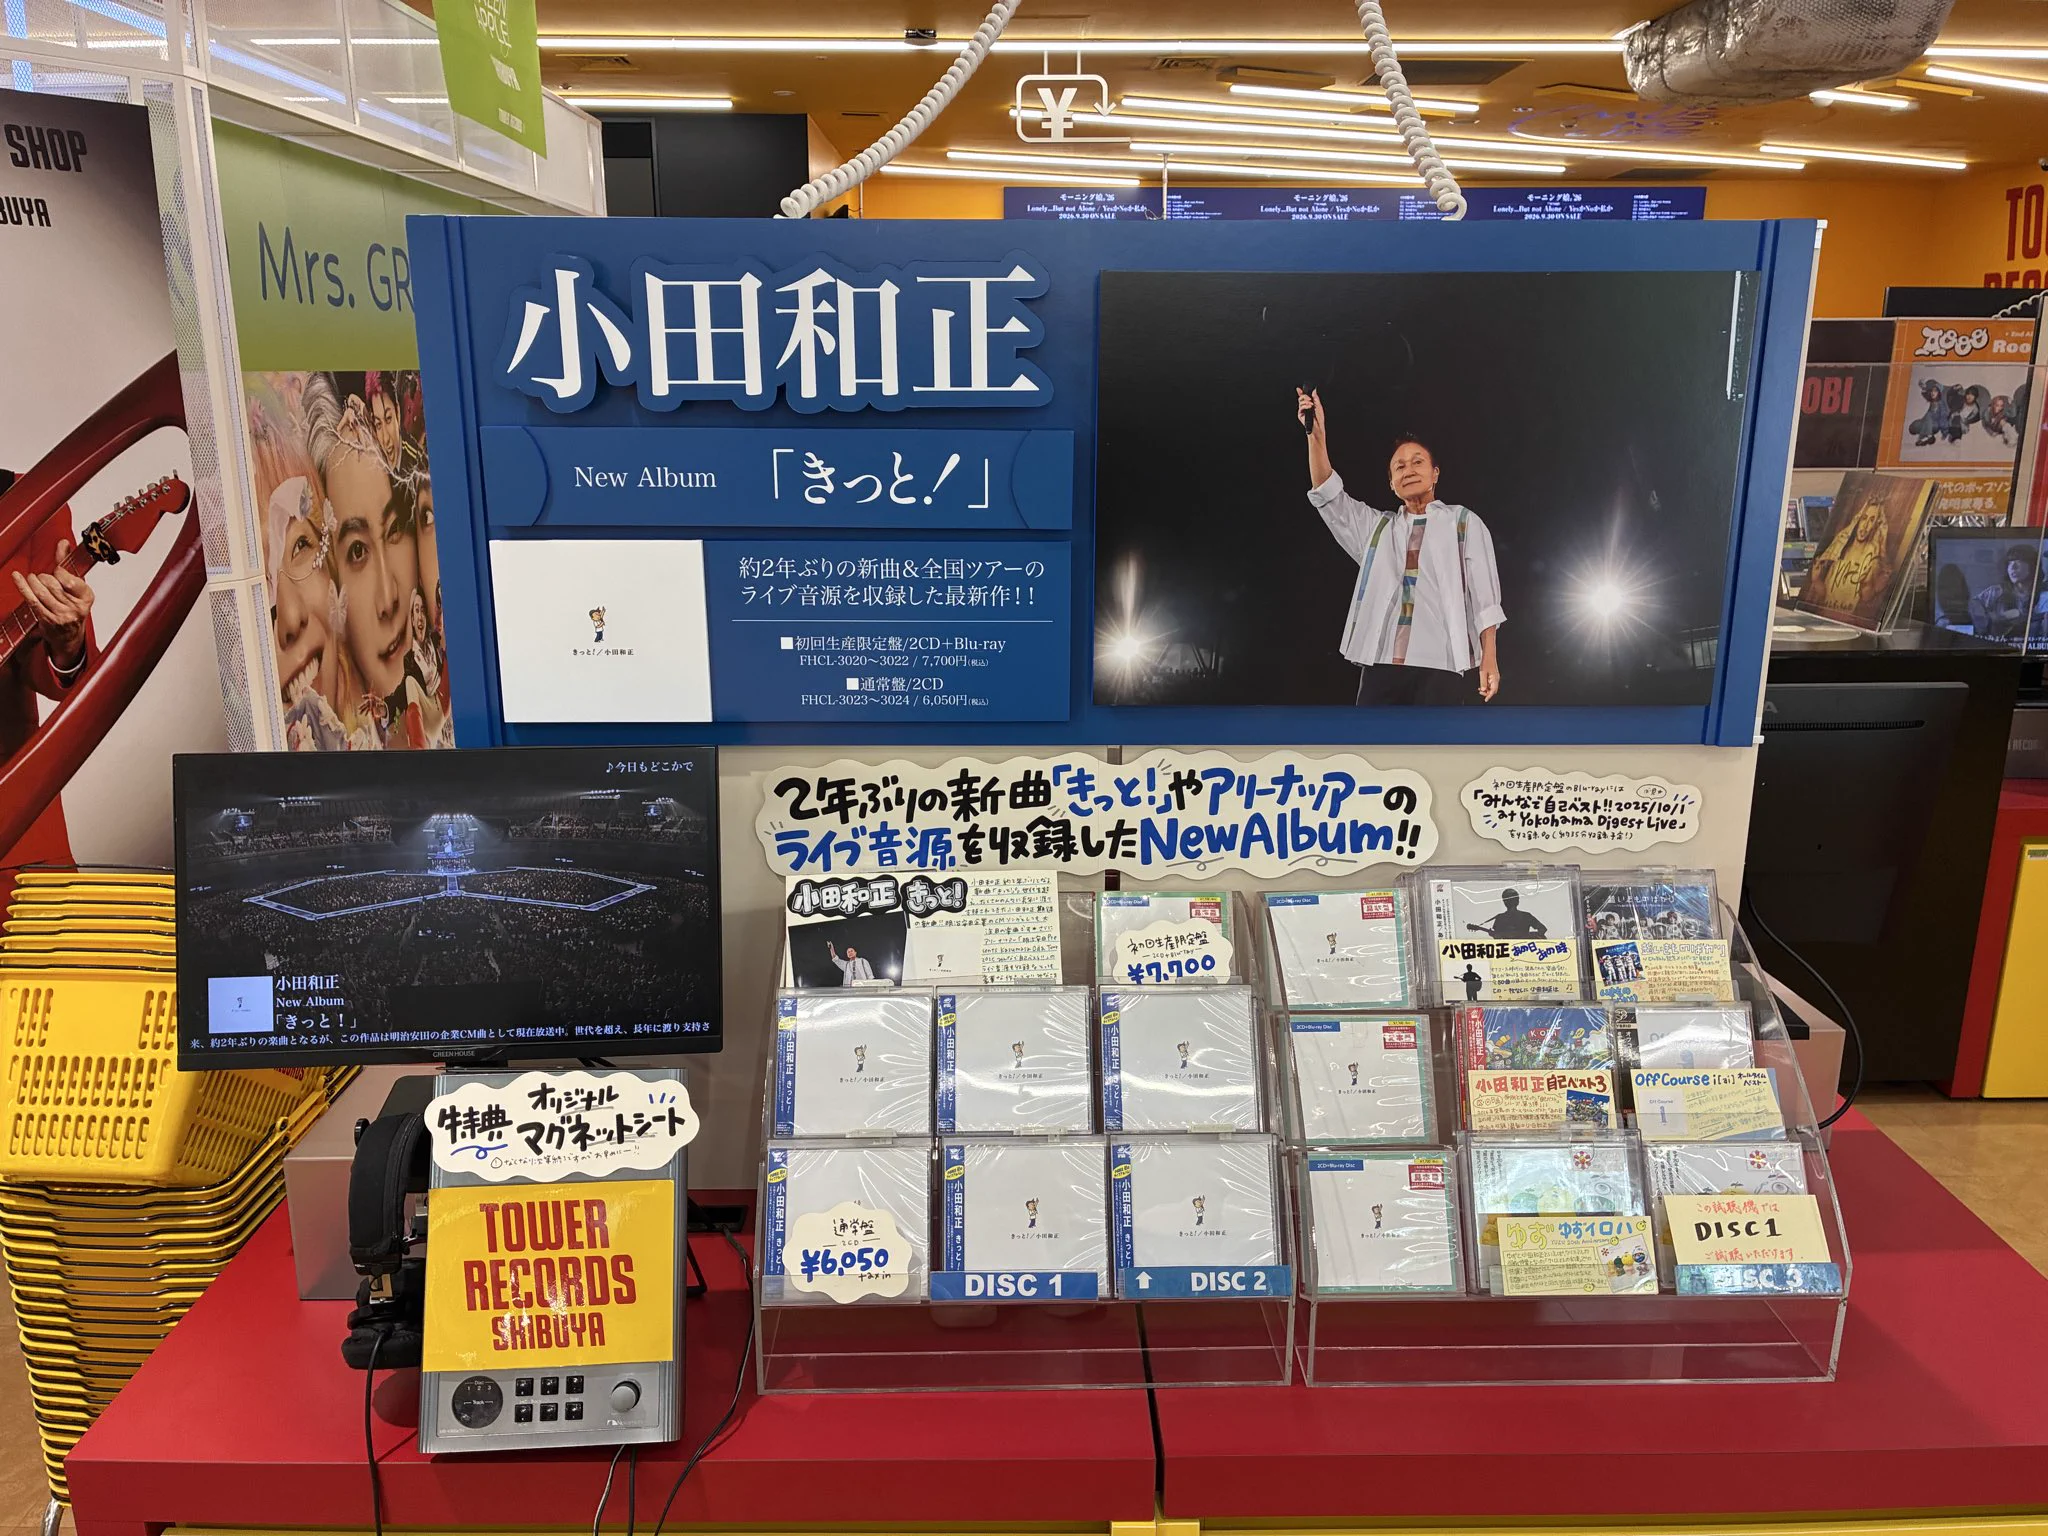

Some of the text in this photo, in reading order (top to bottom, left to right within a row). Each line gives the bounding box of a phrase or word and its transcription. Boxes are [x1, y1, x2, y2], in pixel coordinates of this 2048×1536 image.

[474, 3, 512, 48] APPLE
[4, 124, 87, 172] SHOP
[2006, 184, 2048, 261] TO
[258, 221, 356, 309] Mrs.
[507, 264, 1040, 398] 小田和正
[574, 448, 989, 510] New Album 「きっと!」
[739, 557, 1045, 581] 約2年ぶりの新曲&全国ツアーの
[741, 585, 1035, 607] ライブ音源を収録した最新作!!
[800, 655, 909, 667] FHCL-3020〜3022
[922, 655, 989, 668] 7,700円(税込)
[860, 677, 943, 691] 通常盤/2CD
[801, 694, 910, 706] FHCL-3023〜3024
[922, 694, 989, 707] 6,050円(税込)
[1497, 810, 1516, 822] at
[1519, 812, 1594, 829] Yokohama
[1597, 814, 1644, 830] Digest
[792, 879, 963, 914] 小田和正 きっと!
[1127, 931, 1209, 955] 初回生産限定盤
[1442, 943, 1510, 960] 小田和正
[276, 974, 340, 991] 小田和正
[1127, 954, 1216, 984] ¥7,700
[276, 996, 344, 1008] New Album
[786, 1032, 795, 1075] 小田和正
[1110, 1025, 1120, 1069] 小田和正
[528, 1083, 620, 1115] オリジナル
[1475, 1074, 1608, 1093] 小田和正 自己ベスト3
[438, 1104, 513, 1144] 特典
[517, 1106, 685, 1156] マグネットシート
[775, 1183, 786, 1232] 小田和正
[954, 1180, 963, 1229] 小田和正
[1122, 1179, 1132, 1227] 小田和正
[1696, 1200, 1780, 1215] この試聴機では
[480, 1199, 610, 1254] TOWER
[1507, 1221, 1633, 1249] ゆず ゆずイロハ
[800, 1248, 888, 1282] ¥6,050
[858, 1271, 891, 1281] tax in
[1191, 1271, 1266, 1291] DISC 2
[1786, 1268, 1803, 1288] 3
[463, 1255, 636, 1311] RECORDS
[965, 1274, 1062, 1296] DISC 1
[491, 1312, 606, 1351] SHIBUYA
